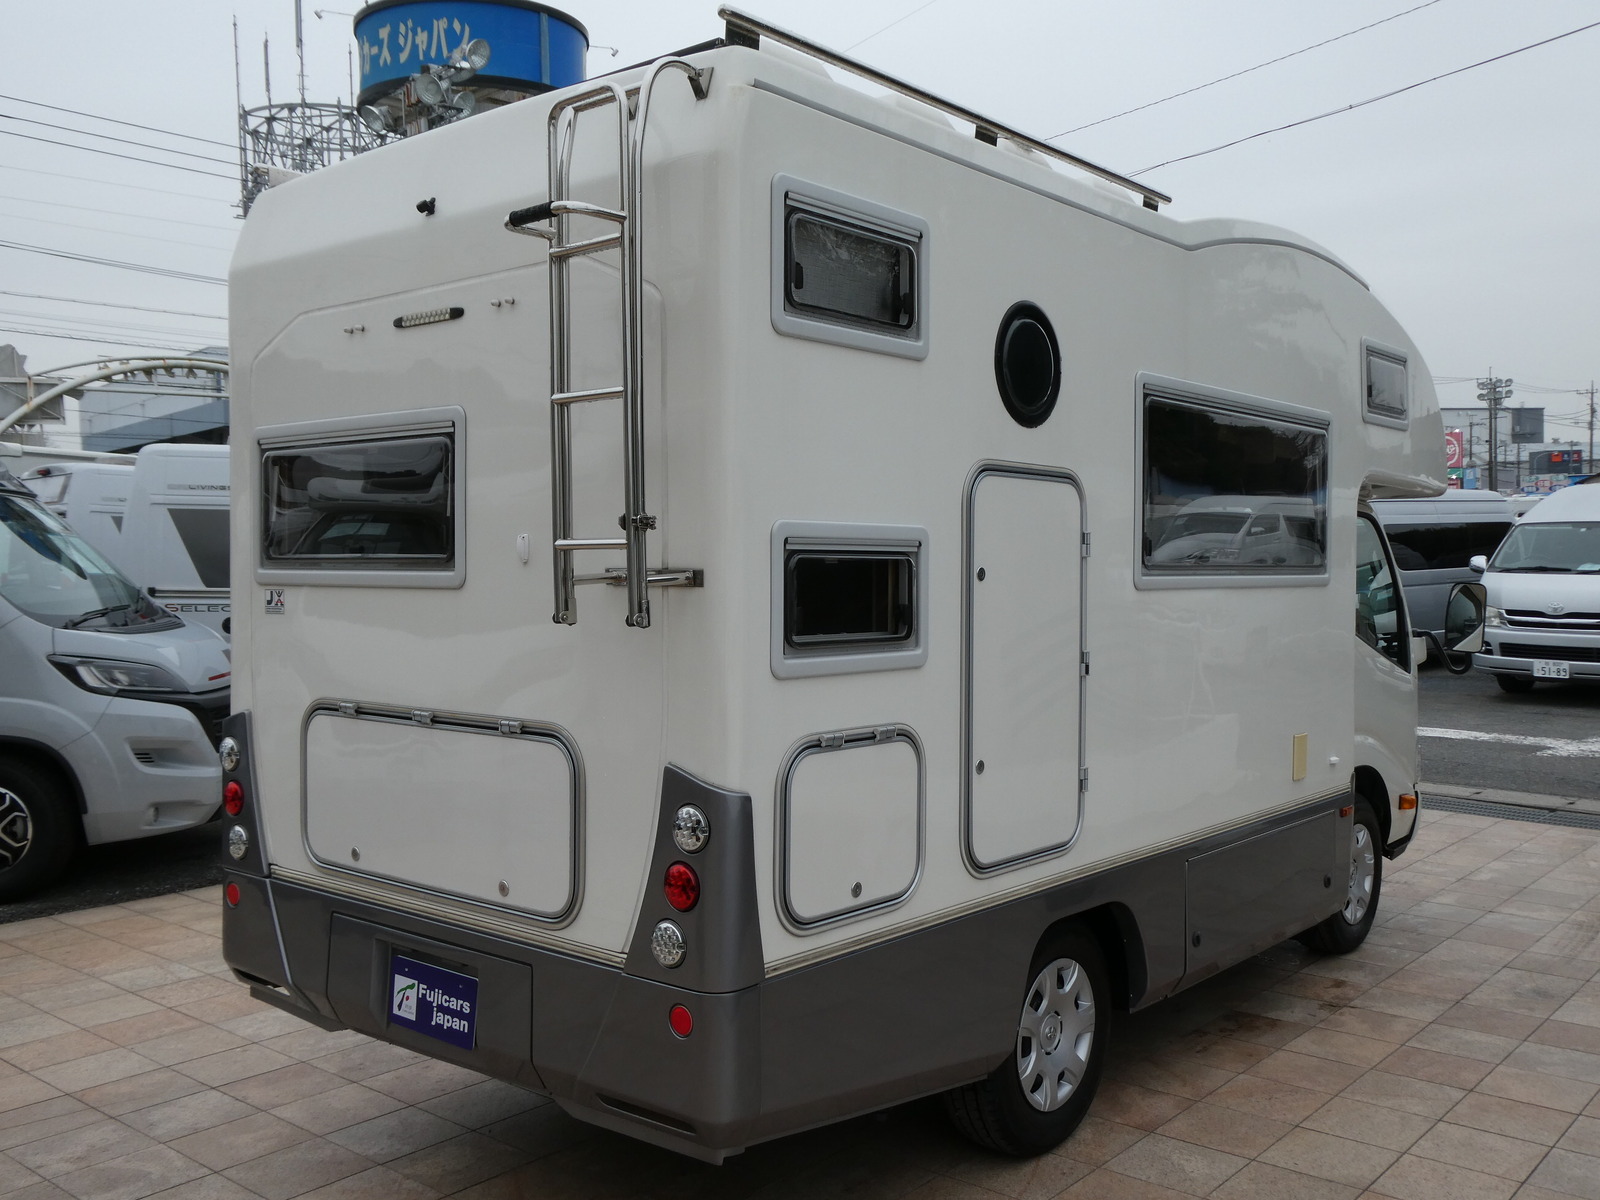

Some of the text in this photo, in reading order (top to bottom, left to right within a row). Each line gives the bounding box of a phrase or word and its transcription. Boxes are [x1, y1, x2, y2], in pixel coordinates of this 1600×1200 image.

[1541, 666, 1568, 677] 51-89
[418, 983, 471, 1014] Fujicars
[431, 1007, 469, 1033] japan
